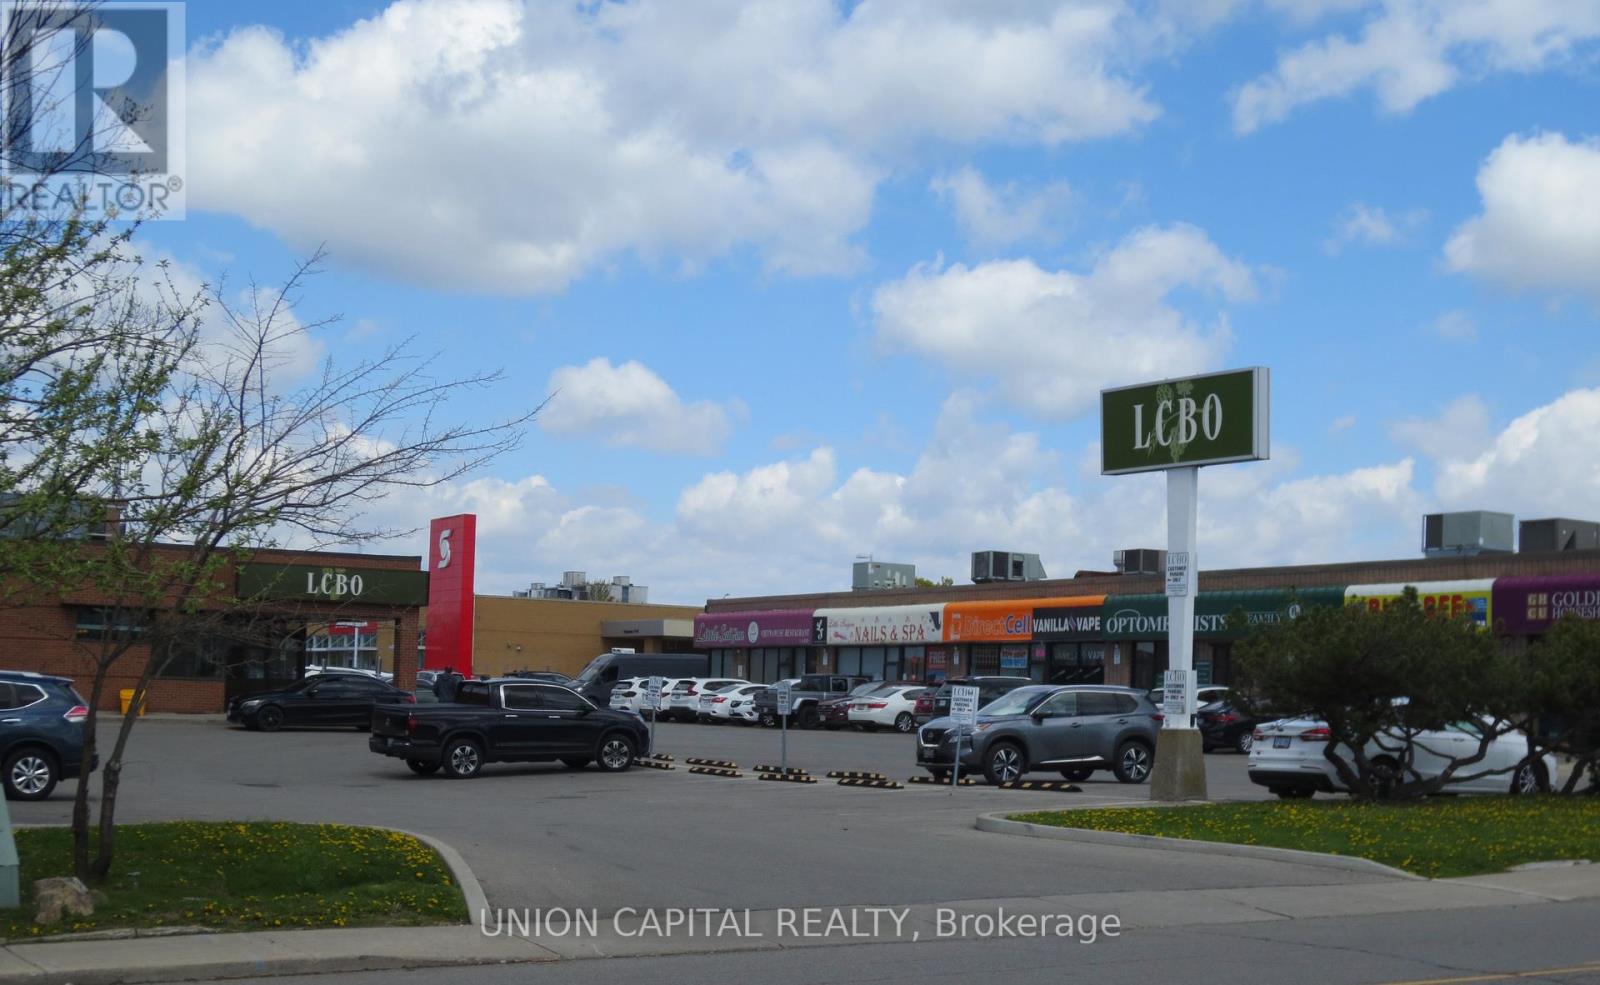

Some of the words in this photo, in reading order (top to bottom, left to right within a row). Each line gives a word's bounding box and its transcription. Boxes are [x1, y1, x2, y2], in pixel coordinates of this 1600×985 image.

[1133, 393, 1223, 450] LCBO
[306, 572, 364, 596] LCBO
[855, 625, 887, 642] NAILS
[890, 625, 898, 640] &
[902, 624, 925, 640] SPA
[1033, 617, 1069, 633] VANILLA
[1076, 616, 1101, 631] VAPE
